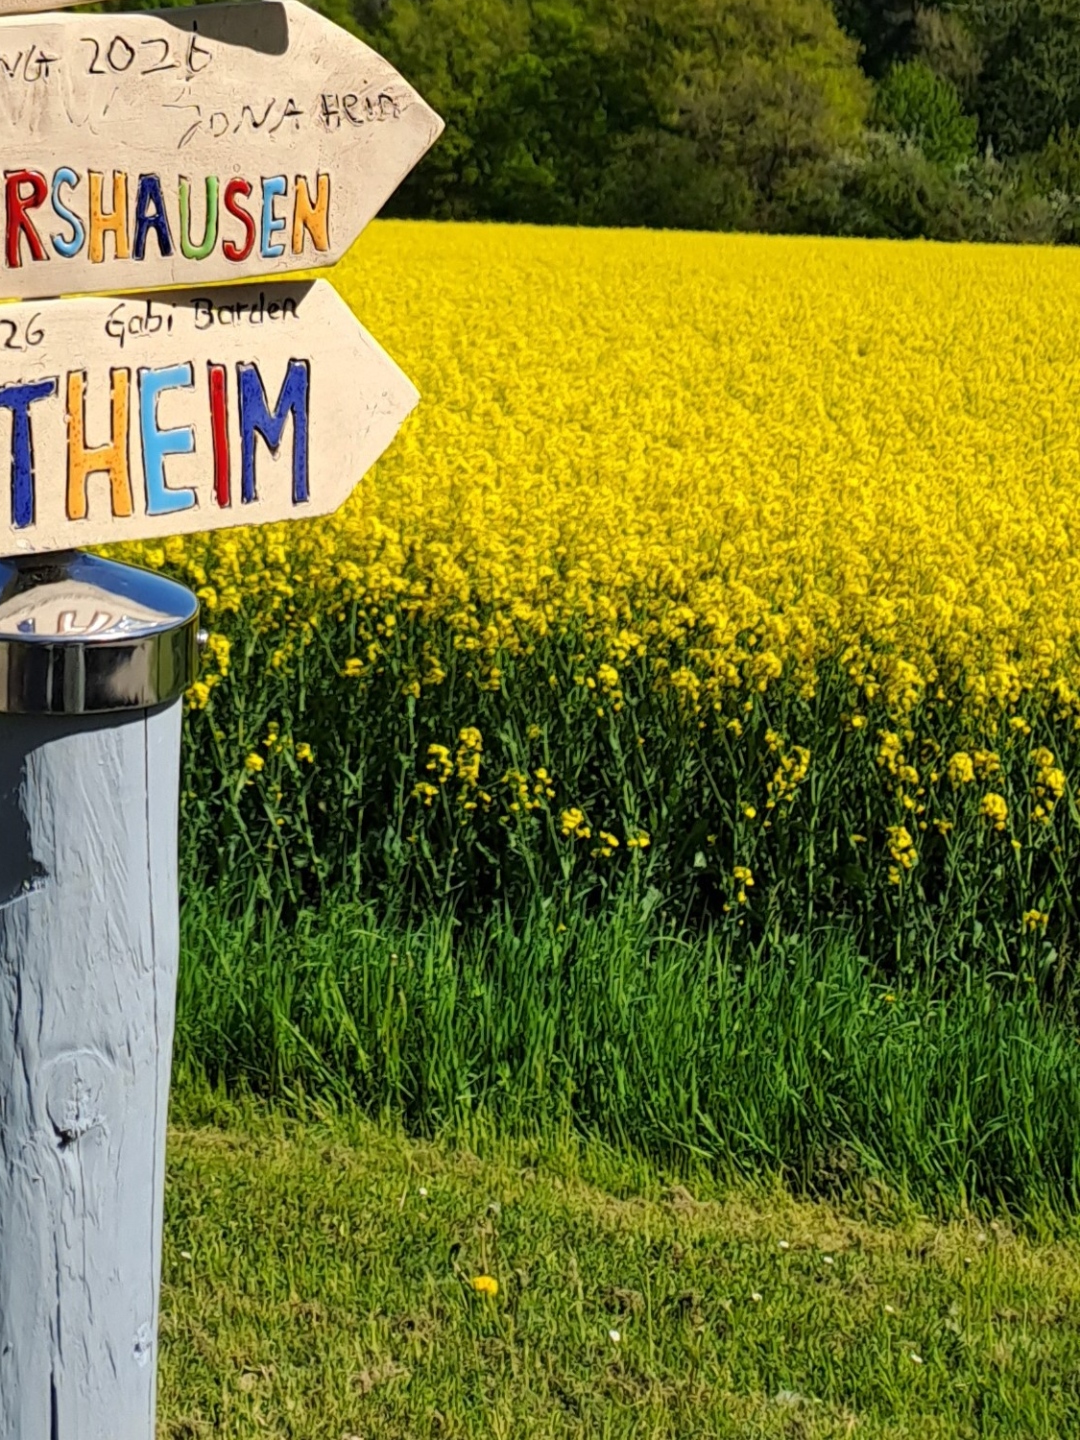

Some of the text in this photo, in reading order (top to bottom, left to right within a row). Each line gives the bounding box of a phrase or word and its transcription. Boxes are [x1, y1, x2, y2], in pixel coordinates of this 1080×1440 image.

[80, 21, 213, 81] 2026
[105, 302, 174, 348] Gabi
[191, 293, 299, 331] Barden
